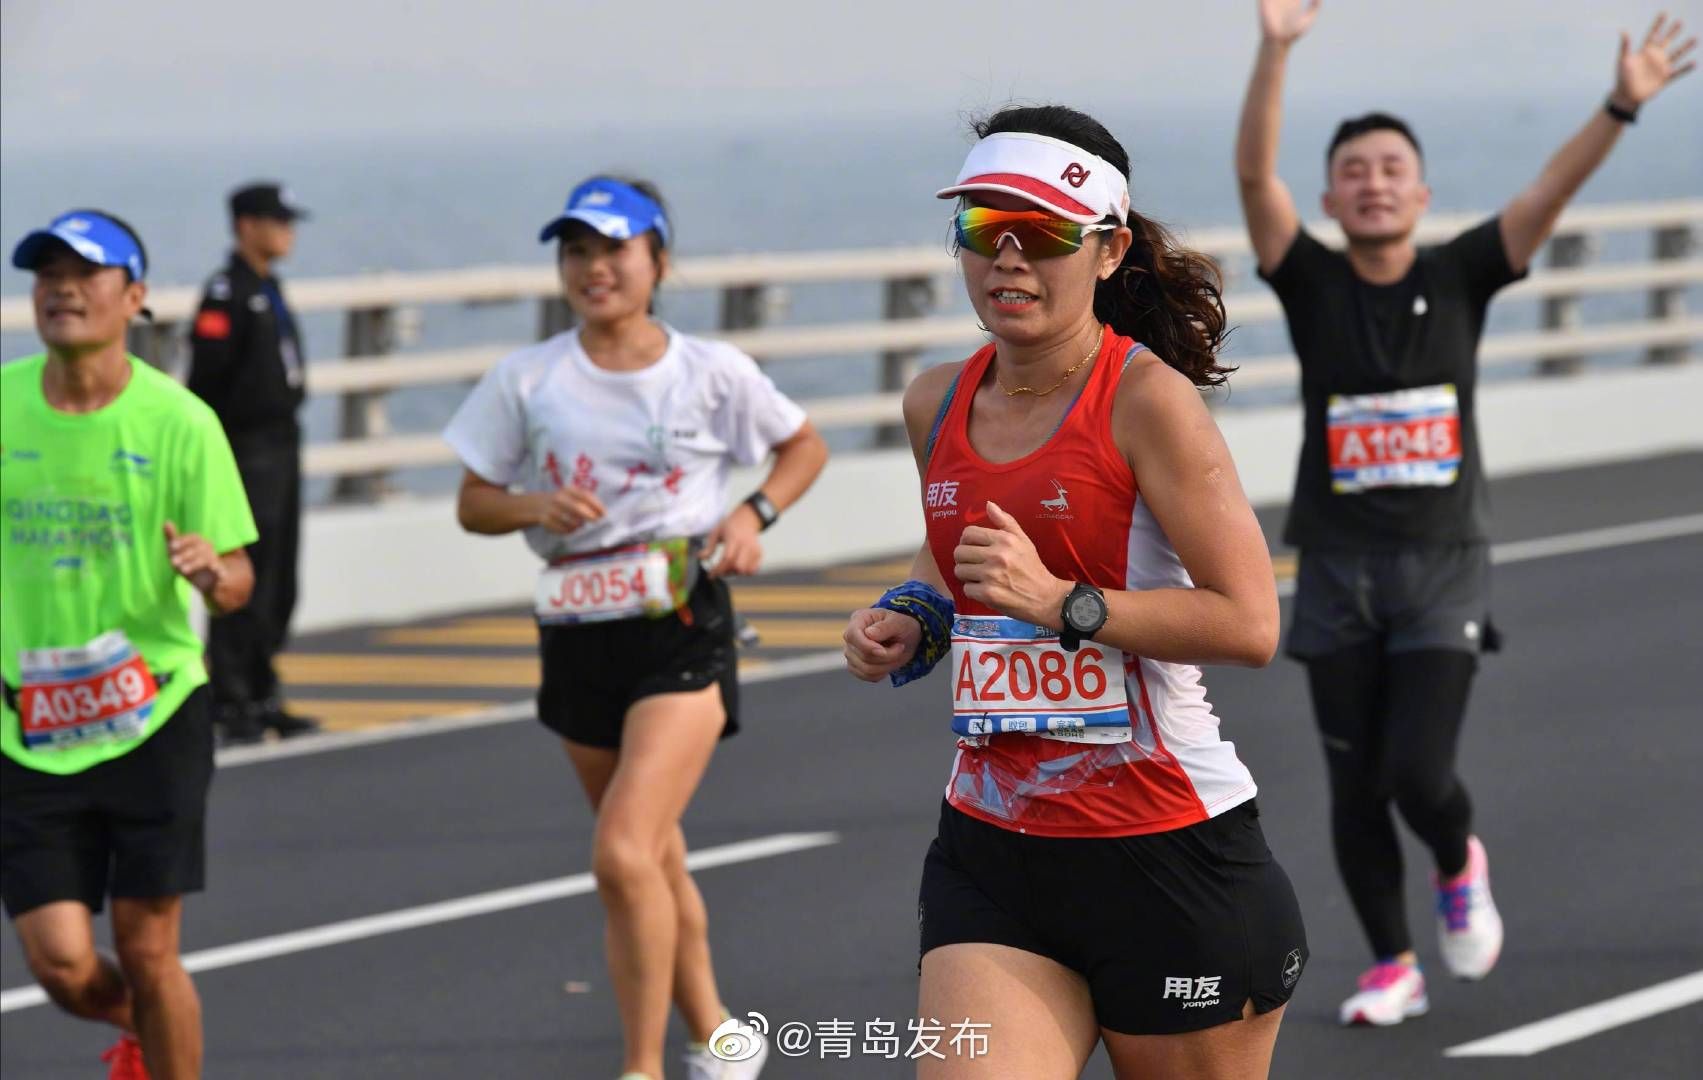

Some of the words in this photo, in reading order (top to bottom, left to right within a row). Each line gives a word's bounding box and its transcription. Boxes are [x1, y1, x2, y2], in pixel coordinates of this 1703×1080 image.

[926, 480, 960, 508] 用友
[551, 566, 647, 607] J0054
[955, 647, 1107, 701] A2086
[31, 666, 145, 727] A0349
[1163, 975, 1222, 999] 用友
[1182, 998, 1220, 1010] yonyou
